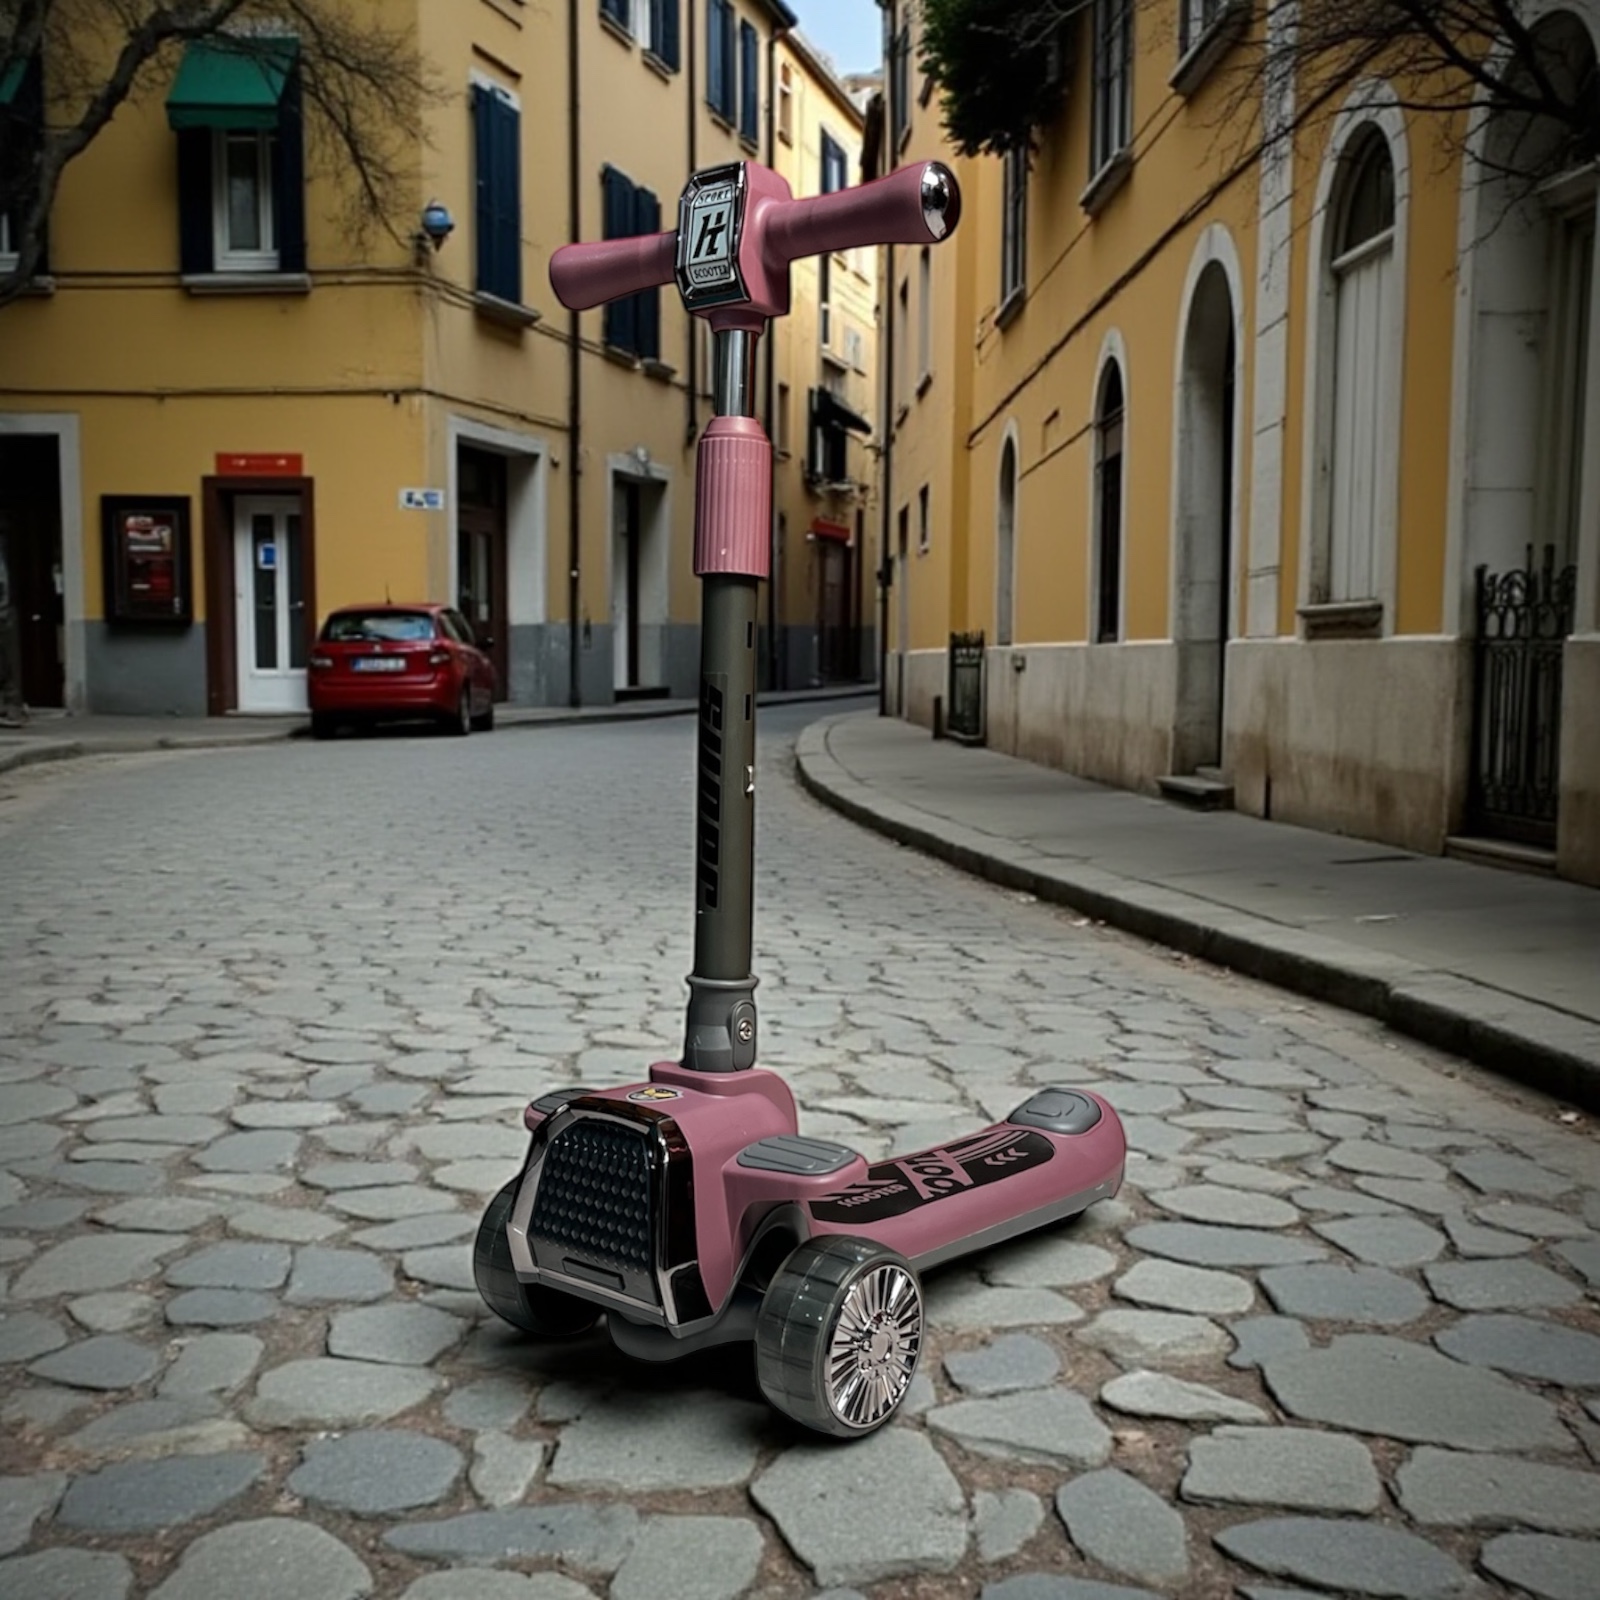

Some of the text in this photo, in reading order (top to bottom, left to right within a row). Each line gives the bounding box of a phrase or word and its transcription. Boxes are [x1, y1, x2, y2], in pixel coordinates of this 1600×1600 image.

[698, 189, 730, 204] SPORT
[694, 264, 728, 279] SCOOTER
[837, 1184, 908, 1208] SCOOTER
